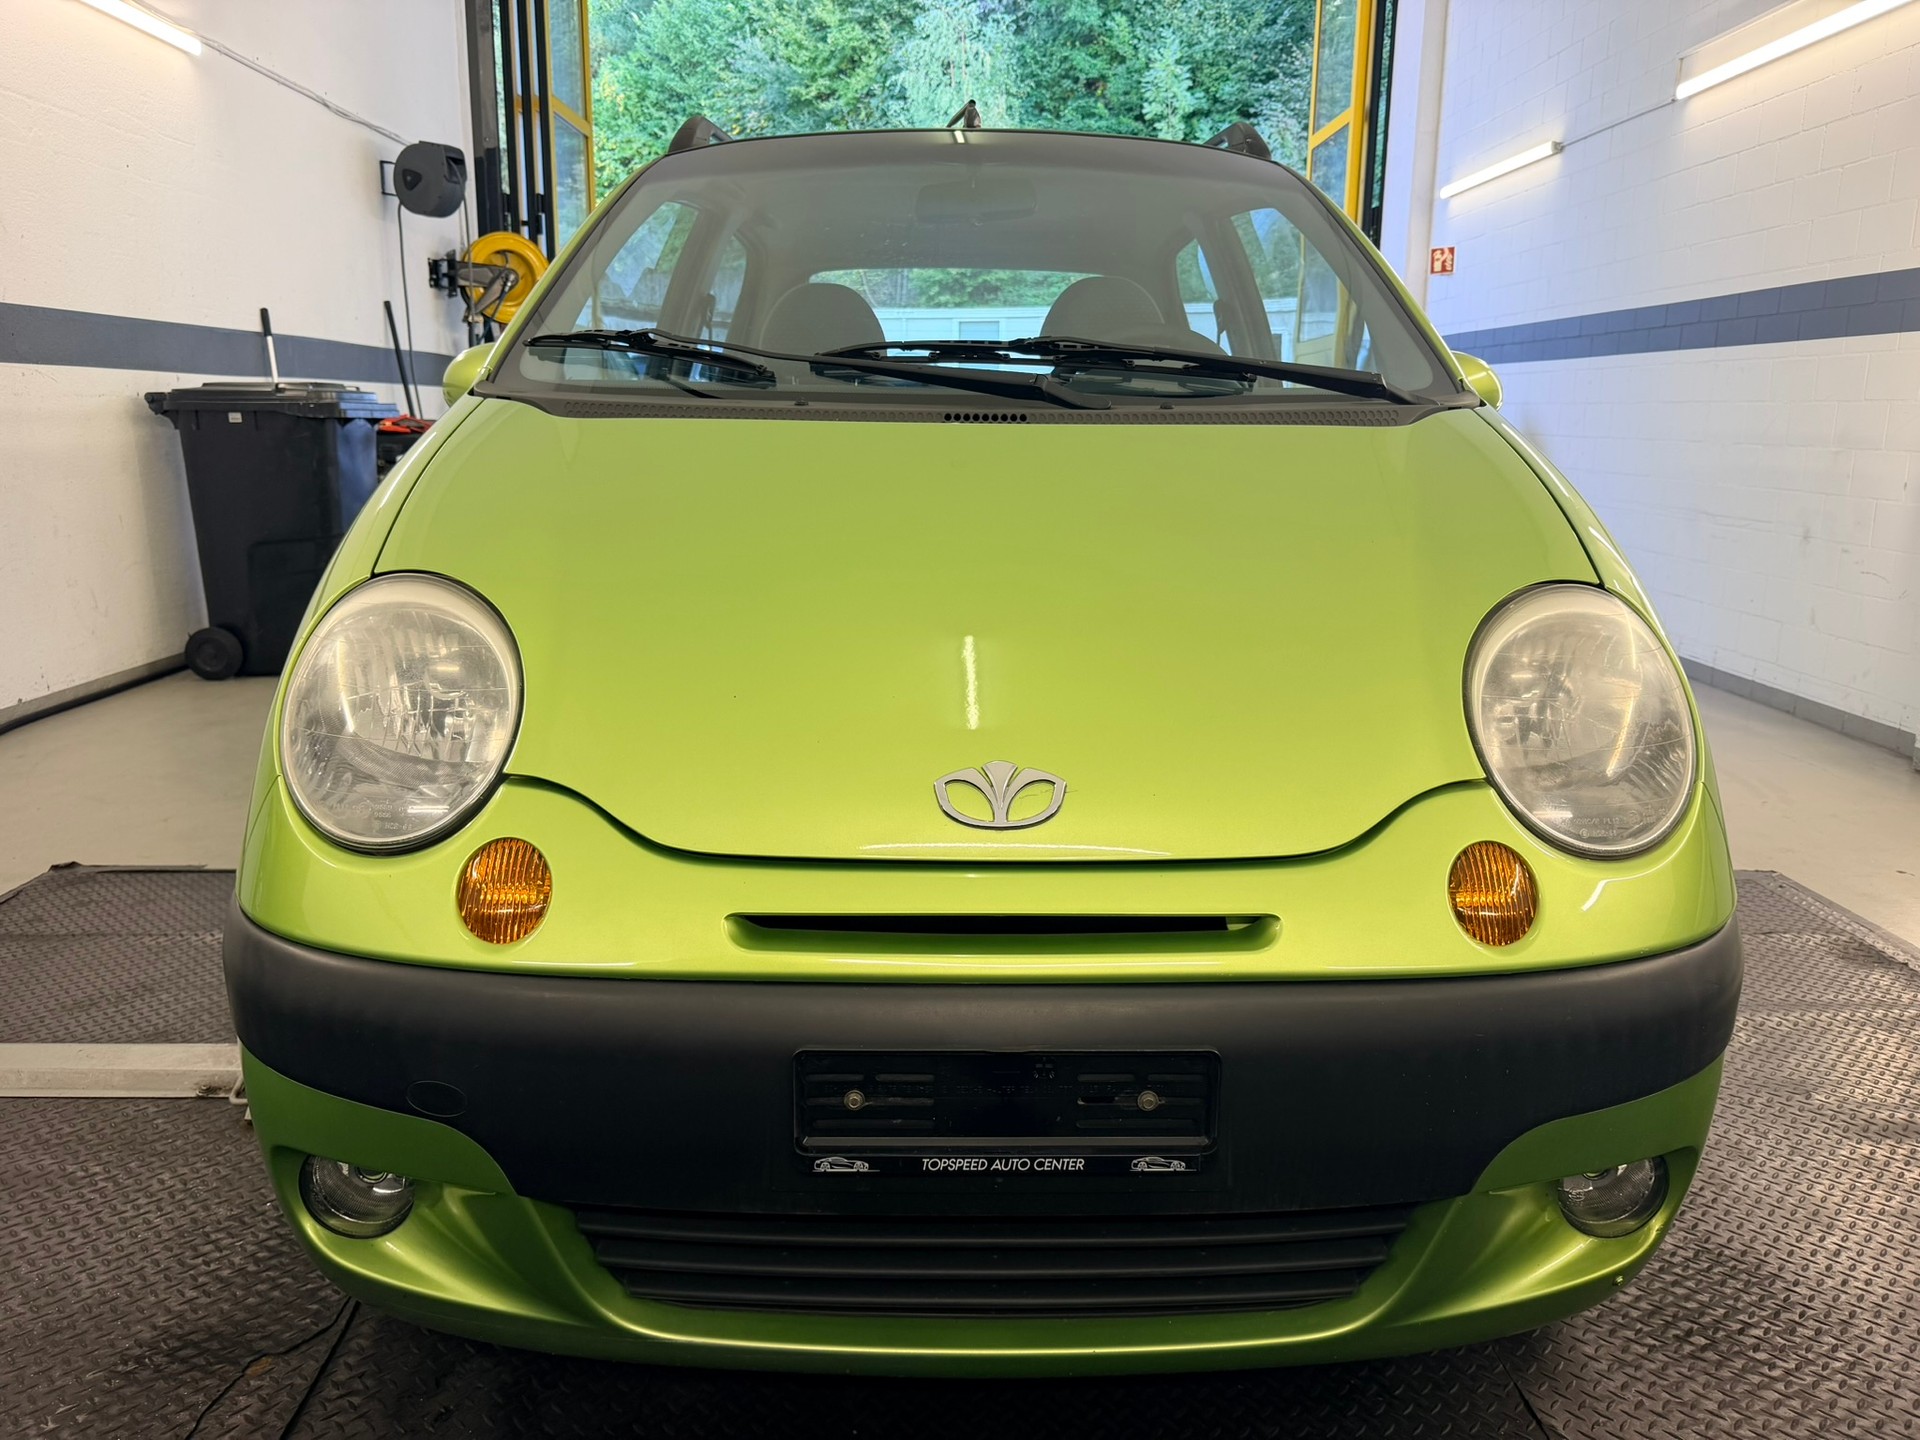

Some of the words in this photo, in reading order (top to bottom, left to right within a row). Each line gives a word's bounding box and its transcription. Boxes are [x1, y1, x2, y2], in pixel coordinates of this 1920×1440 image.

[922, 1158, 988, 1171] TOPSPEED
[990, 1158, 1031, 1171] AUTO
[1033, 1158, 1085, 1171] CENTER
